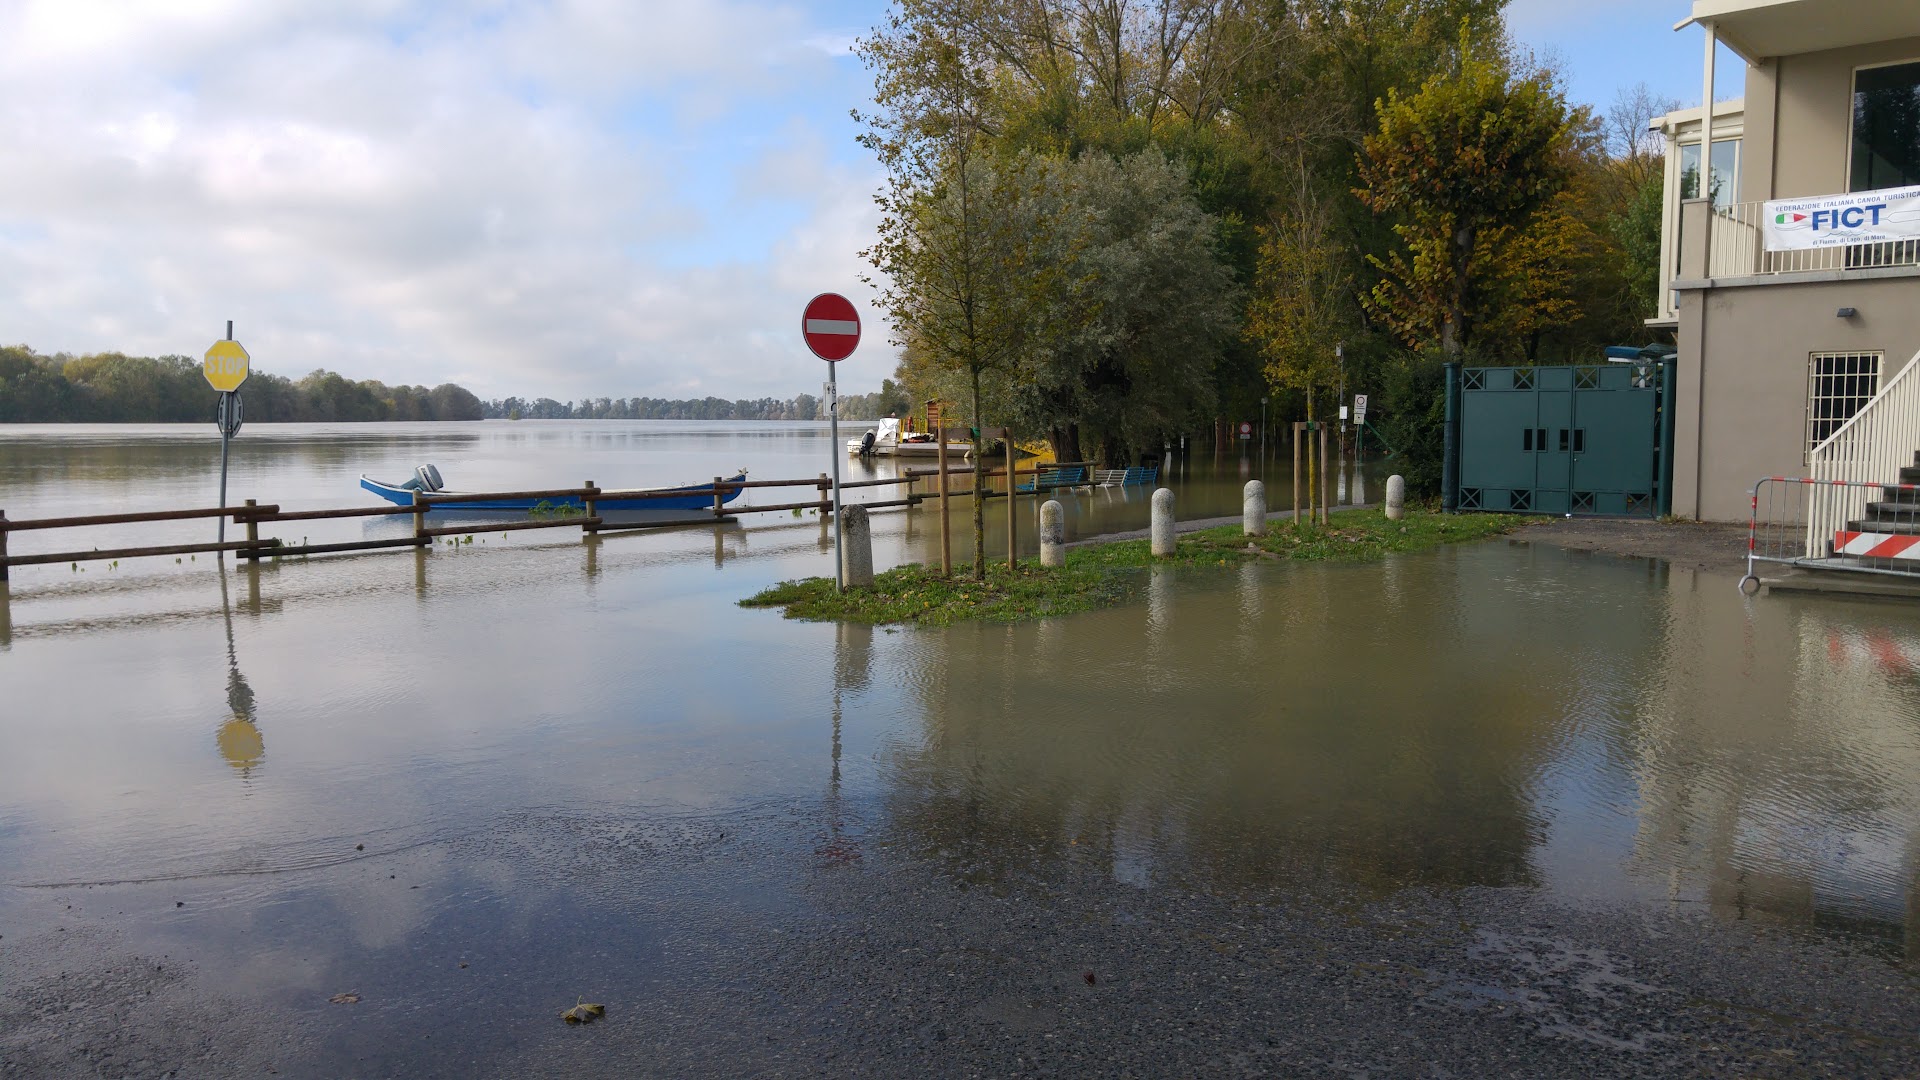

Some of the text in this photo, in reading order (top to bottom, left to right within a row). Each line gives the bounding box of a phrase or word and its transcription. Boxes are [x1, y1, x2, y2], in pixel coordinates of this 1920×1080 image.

[1775, 203, 1820, 212] FEDERAZIONE
[1823, 199, 1854, 208] ITALIANA
[1857, 196, 1880, 204] CANOA
[1812, 203, 1887, 231] FICT
[207, 355, 246, 376] STOP
